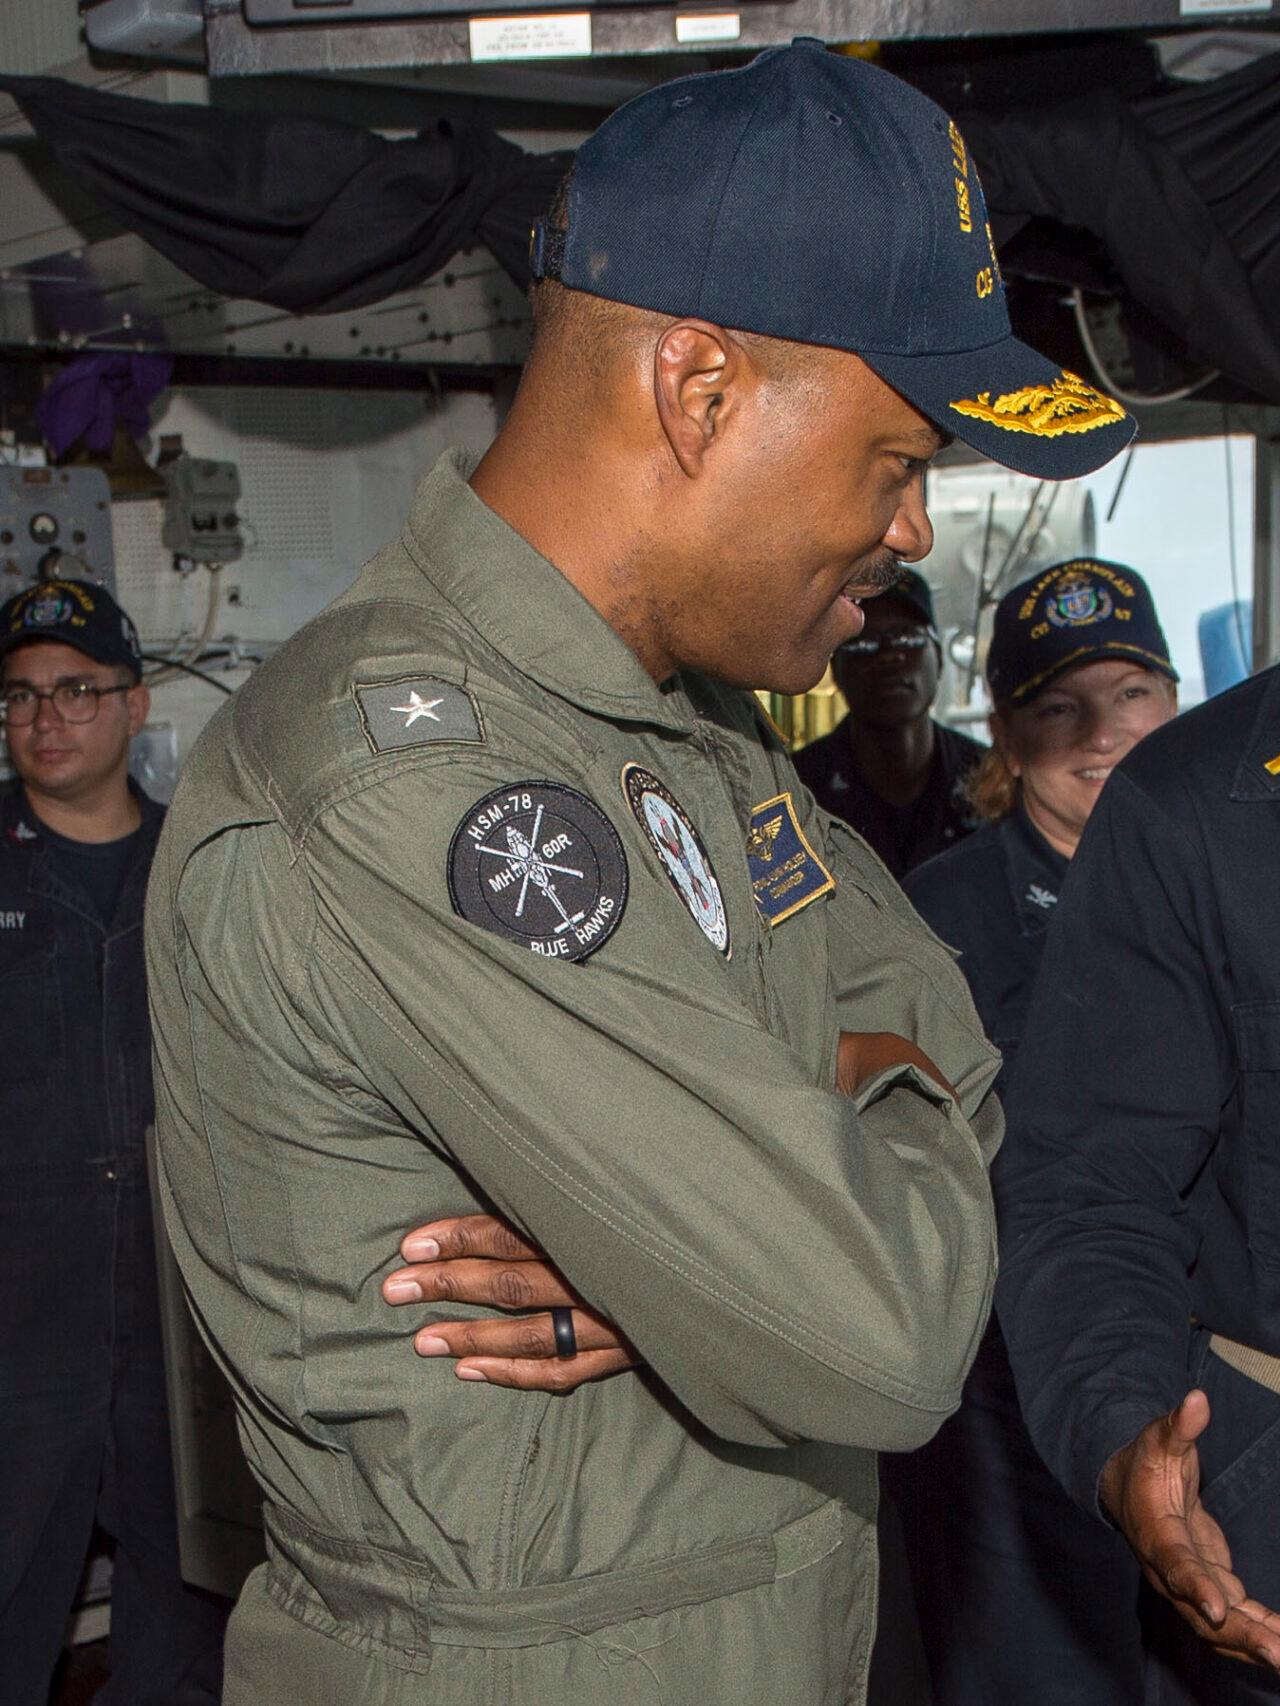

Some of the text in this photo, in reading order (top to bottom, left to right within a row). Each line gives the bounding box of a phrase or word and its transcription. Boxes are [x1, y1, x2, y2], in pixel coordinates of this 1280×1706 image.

[467, 793, 532, 840] HSM-78
[488, 833, 573, 892] MH 60R
[530, 896, 615, 957] BLUE HAWKS
